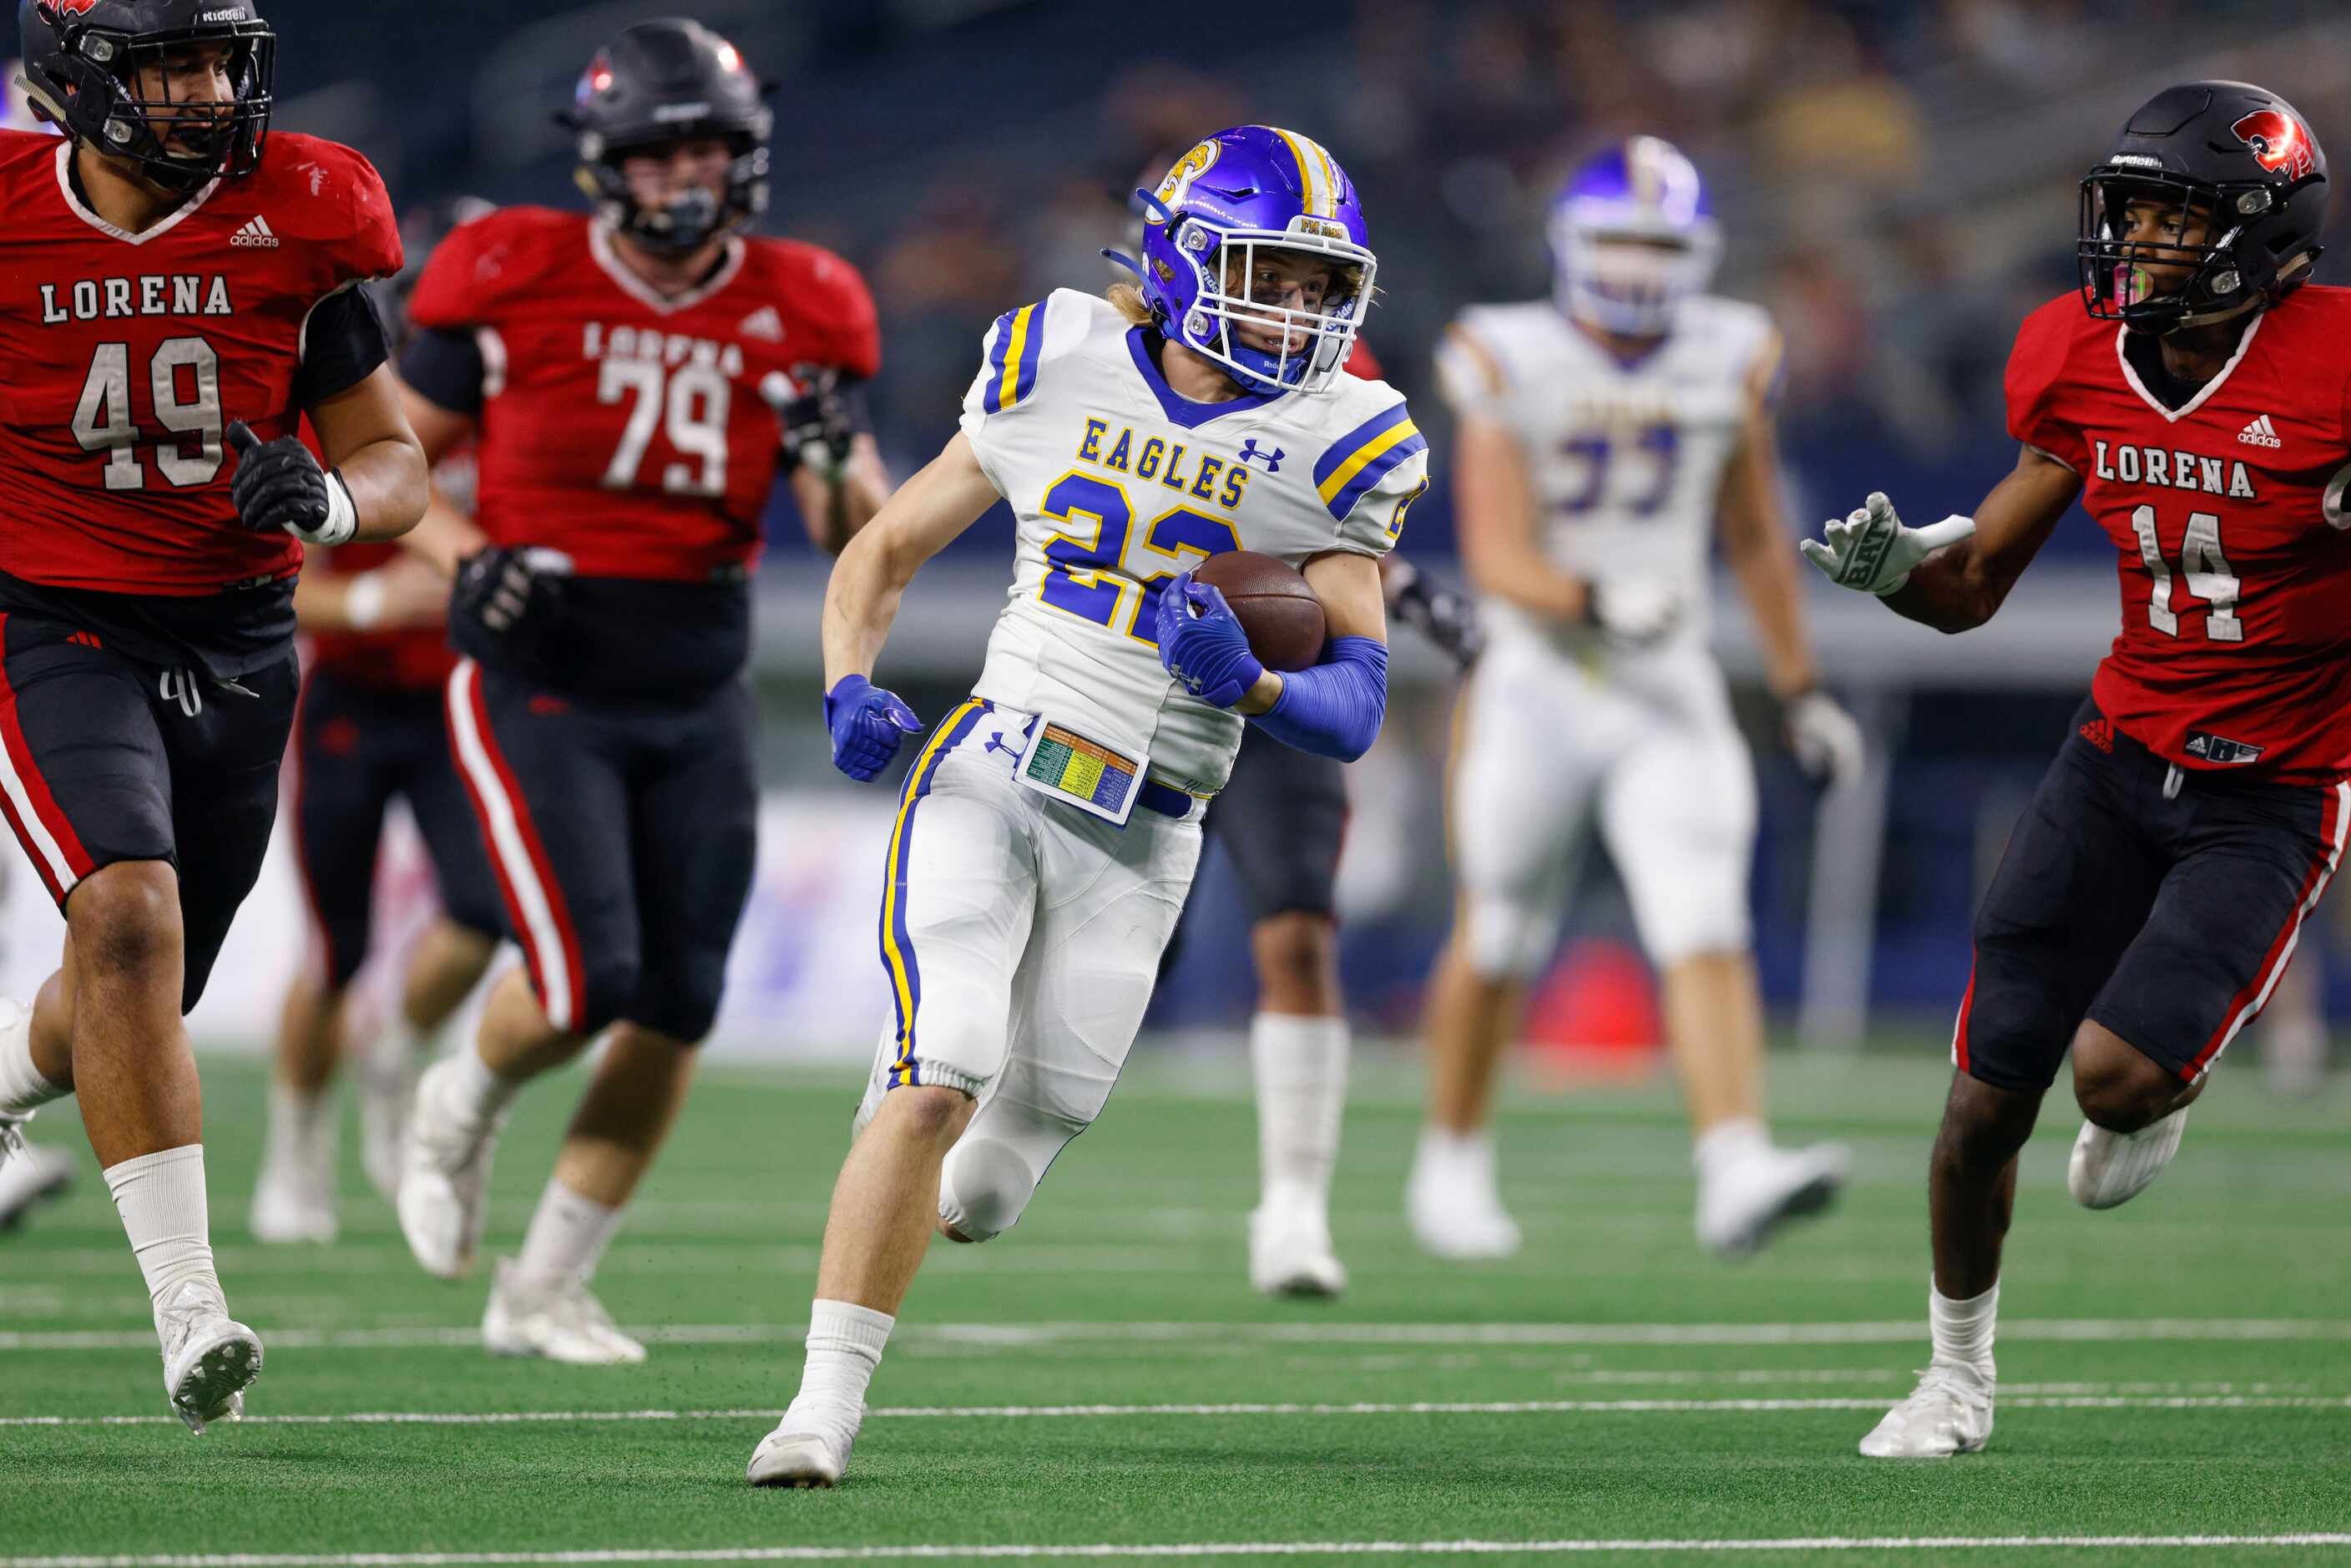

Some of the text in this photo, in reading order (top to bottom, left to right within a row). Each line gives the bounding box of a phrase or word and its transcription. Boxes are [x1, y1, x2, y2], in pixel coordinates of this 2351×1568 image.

[202, 7, 246, 22] Riddell
[230, 233, 280, 247] adidas
[1301, 218, 1320, 235] FM
[40, 275, 233, 324] LORENA
[70, 336, 224, 491] 49
[597, 359, 732, 496] 79
[2237, 431, 2282, 448] adidas
[1075, 415, 1249, 511] EAGLES
[2095, 441, 2256, 498] LORENA
[2131, 503, 2244, 642] 14
